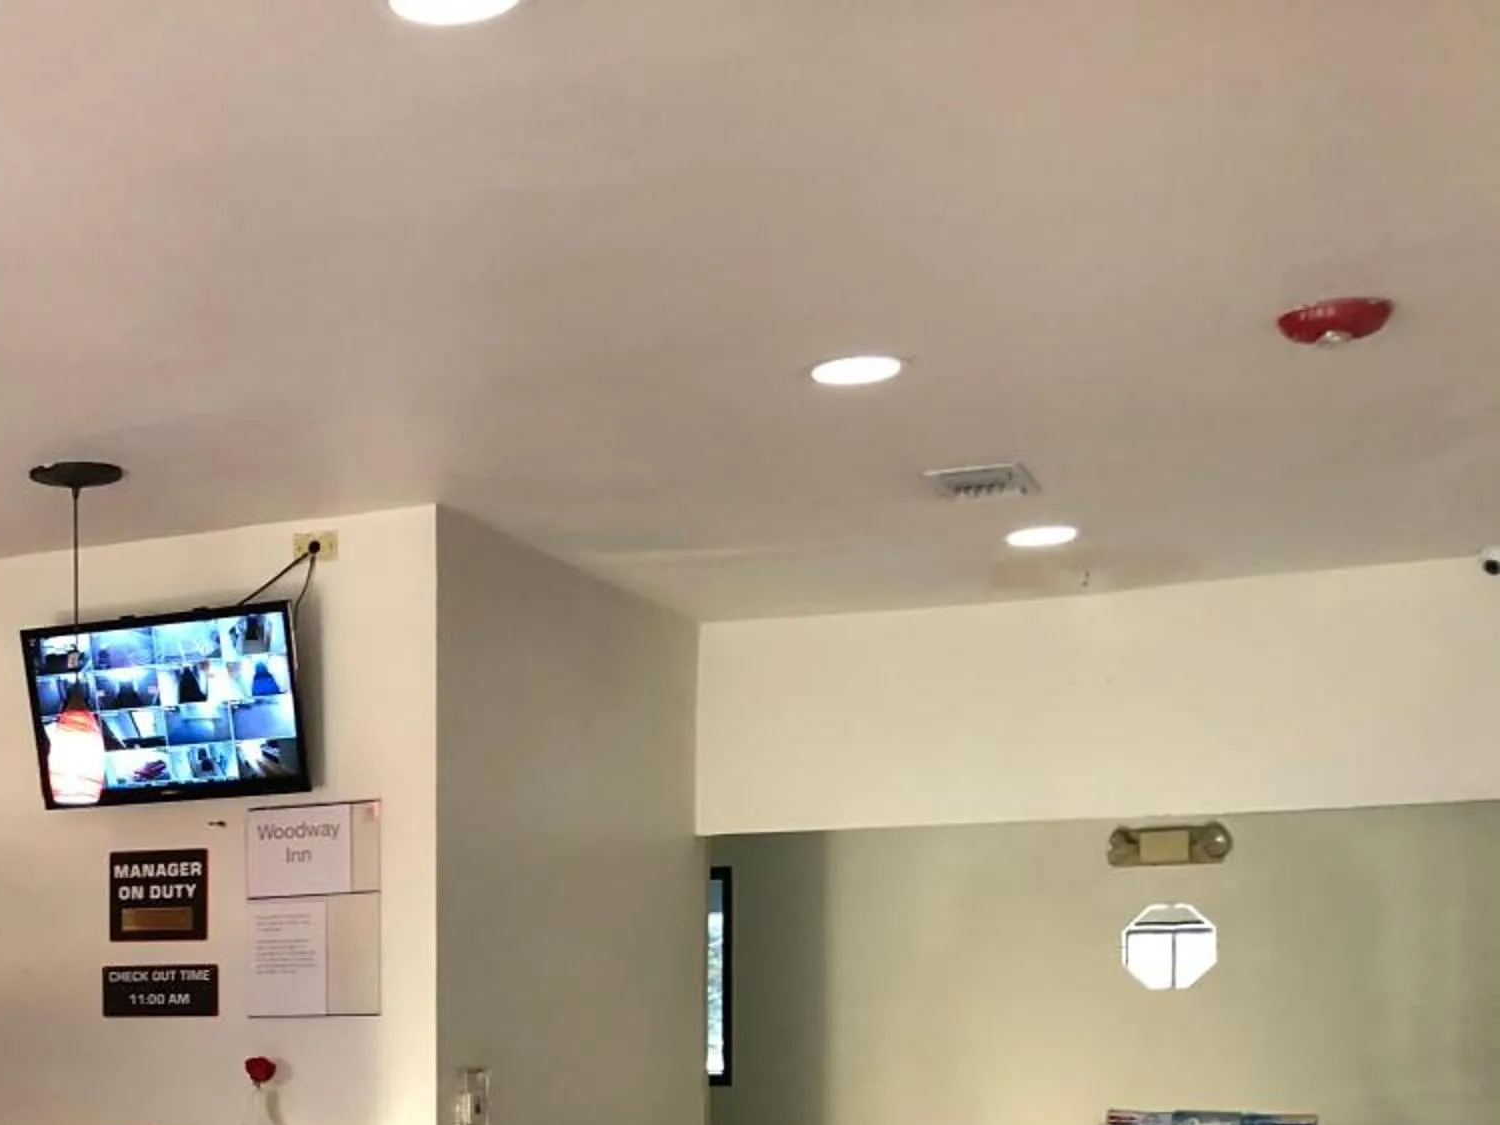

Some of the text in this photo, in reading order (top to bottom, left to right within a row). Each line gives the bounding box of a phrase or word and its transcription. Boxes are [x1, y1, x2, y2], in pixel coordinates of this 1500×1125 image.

[257, 820, 340, 842] Woodway
[285, 847, 312, 864] Inn
[114, 862, 203, 879] MANAGER
[118, 884, 197, 900] ON DUTY
[108, 968, 211, 982] CHECK OUT TIME
[167, 992, 190, 1005] AM
